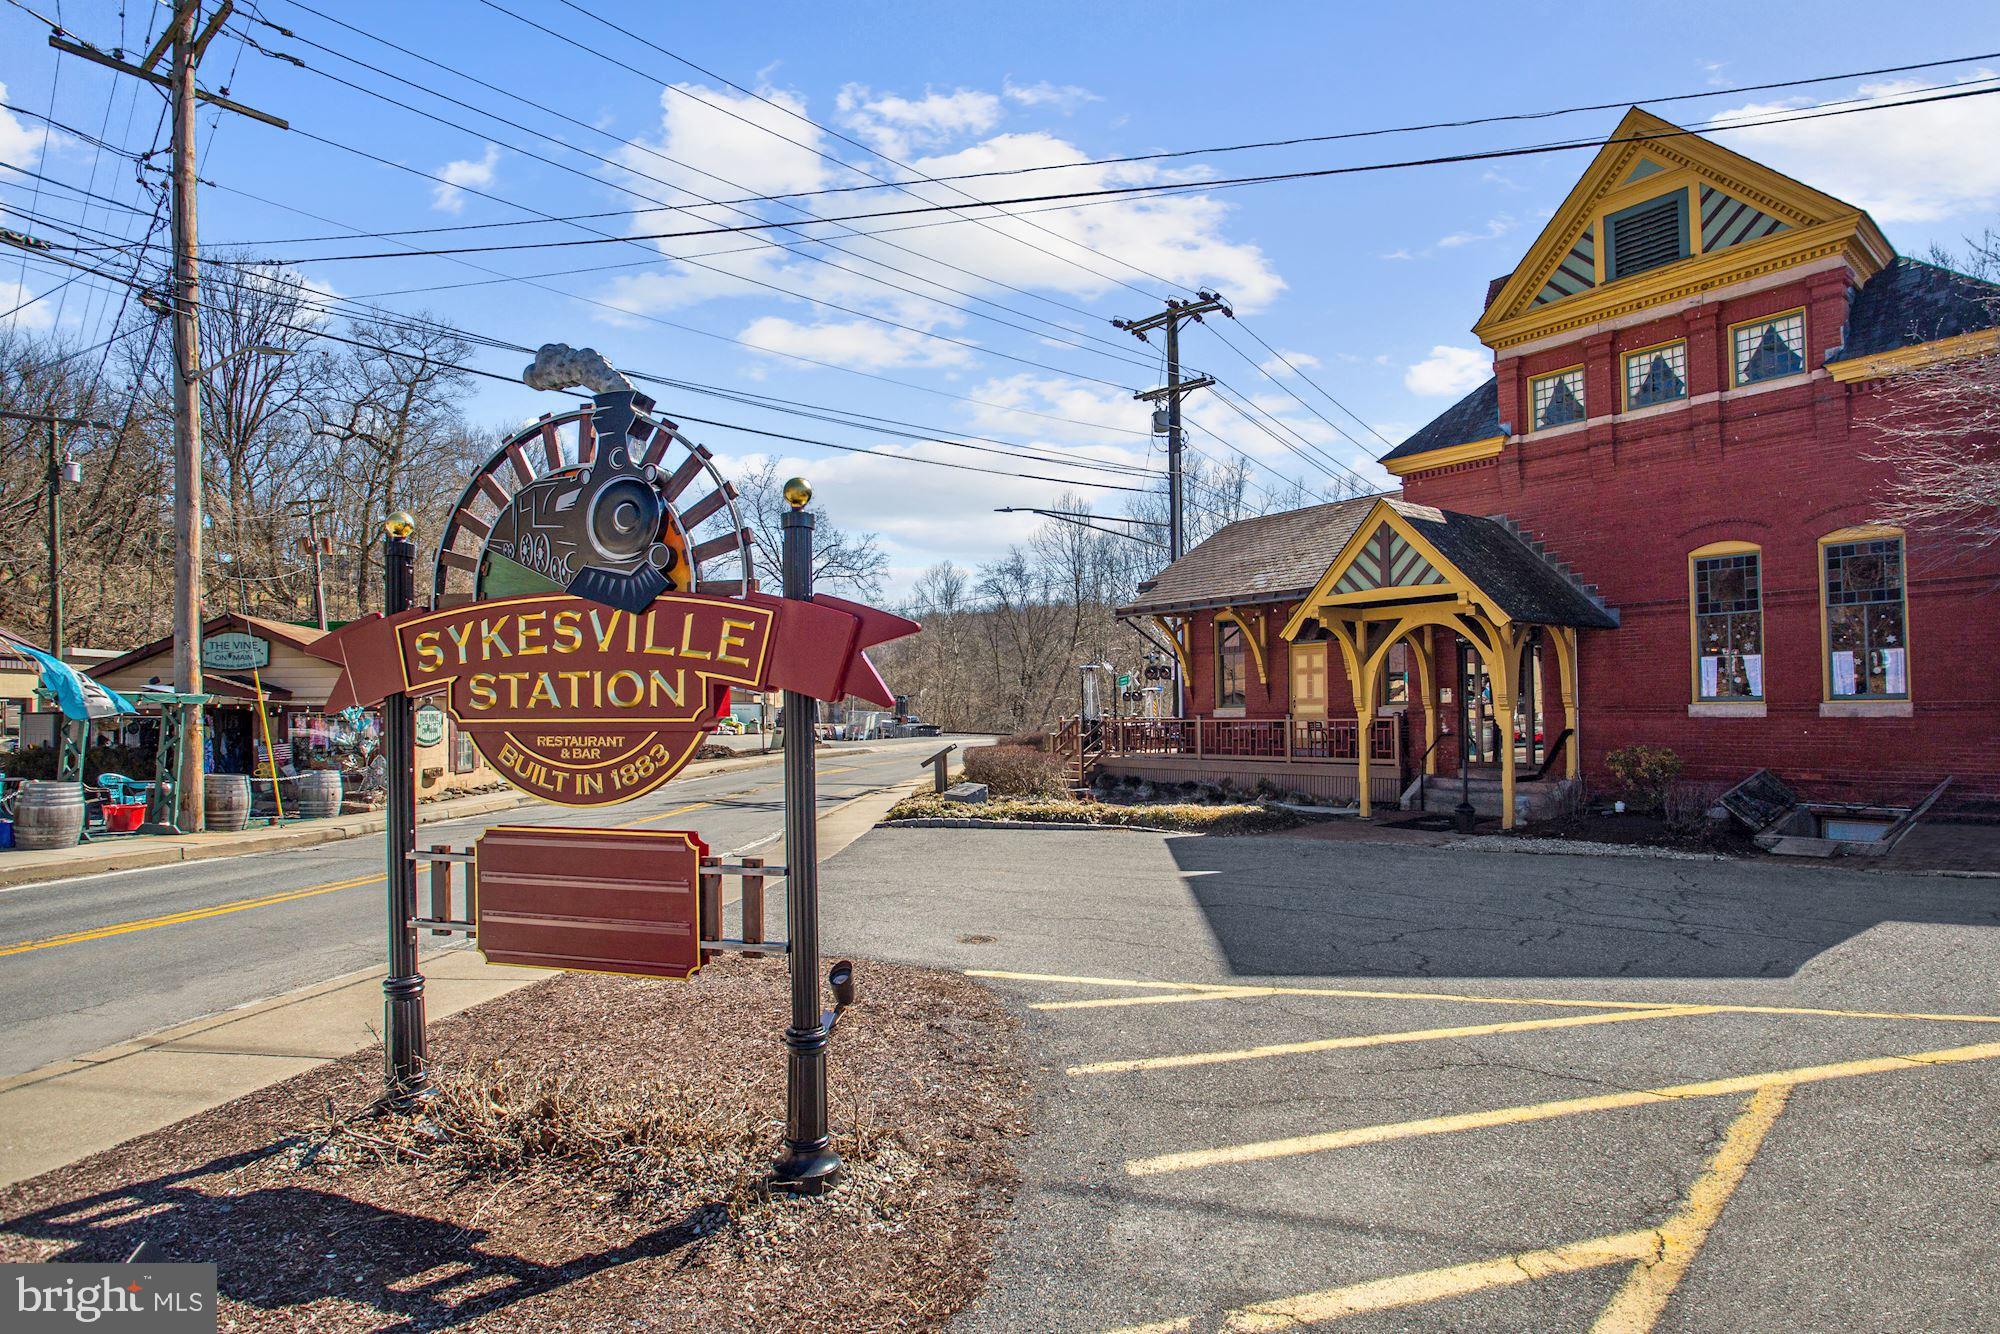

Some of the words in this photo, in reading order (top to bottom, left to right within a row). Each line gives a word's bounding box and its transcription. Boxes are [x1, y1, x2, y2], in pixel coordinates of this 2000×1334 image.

[209, 641, 230, 650] THE
[232, 641, 258, 650] VINE
[414, 608, 755, 673] SYKESVILLE
[468, 668, 686, 711] STATION
[536, 736, 626, 748] RESTAURANT
[560, 748, 571, 759] &
[572, 748, 600, 759] BAR
[497, 742, 570, 793] BUILT
[575, 773, 604, 796] IN
[610, 743, 671, 790] 1883
